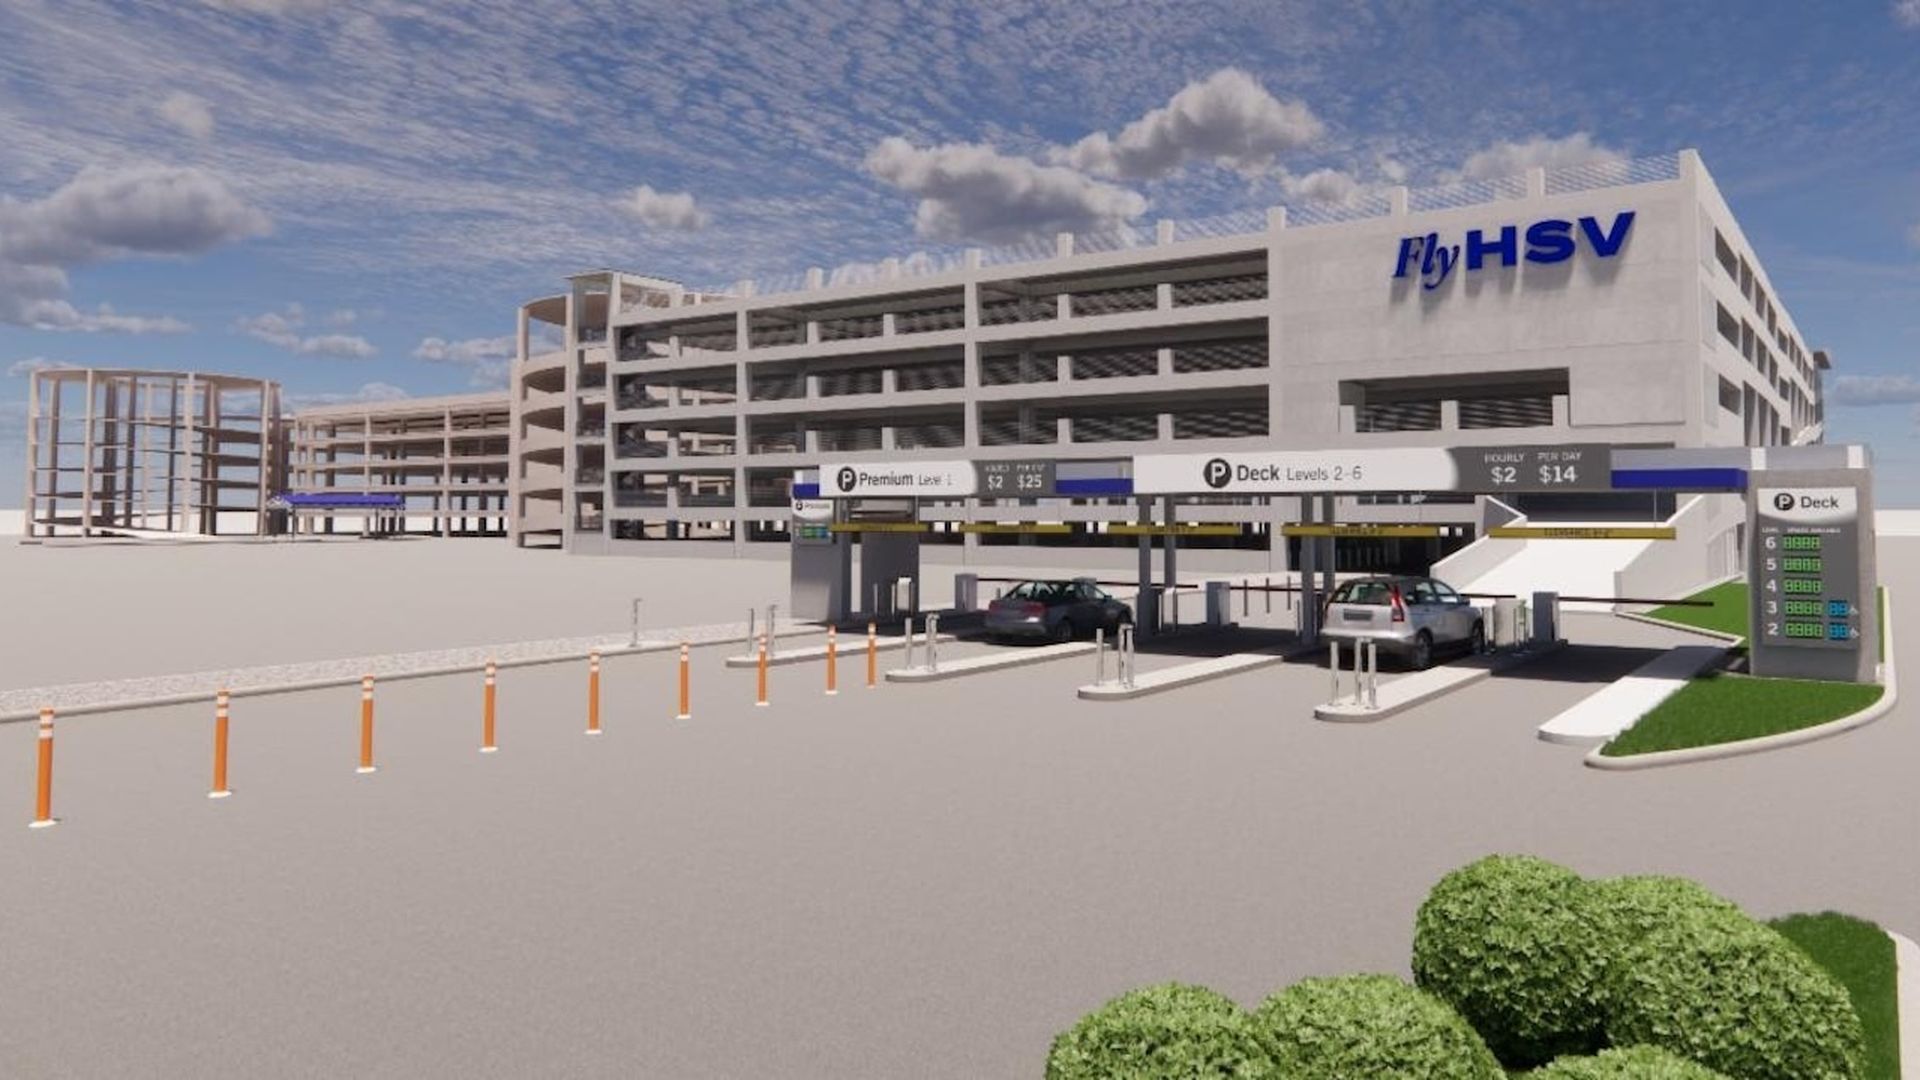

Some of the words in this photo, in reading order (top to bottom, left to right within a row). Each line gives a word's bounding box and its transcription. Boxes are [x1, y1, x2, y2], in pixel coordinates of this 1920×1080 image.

[1562, 451, 1581, 461] DAY
[859, 471, 914, 486] Premium
[1237, 464, 1280, 481] Deck
[1286, 467, 1329, 481] Levels
[1491, 466, 1517, 485] $2
[1539, 465, 1579, 484] $14
[988, 474, 1003, 490] $2
[1016, 474, 1042, 490] $25
[1800, 495, 1840, 509] Deck
[1765, 536, 1776, 549] 6
[1766, 558, 1777, 571] 5
[1766, 579, 1777, 592] 4
[1766, 600, 1777, 614] 3
[1767, 622, 1779, 636] 2
